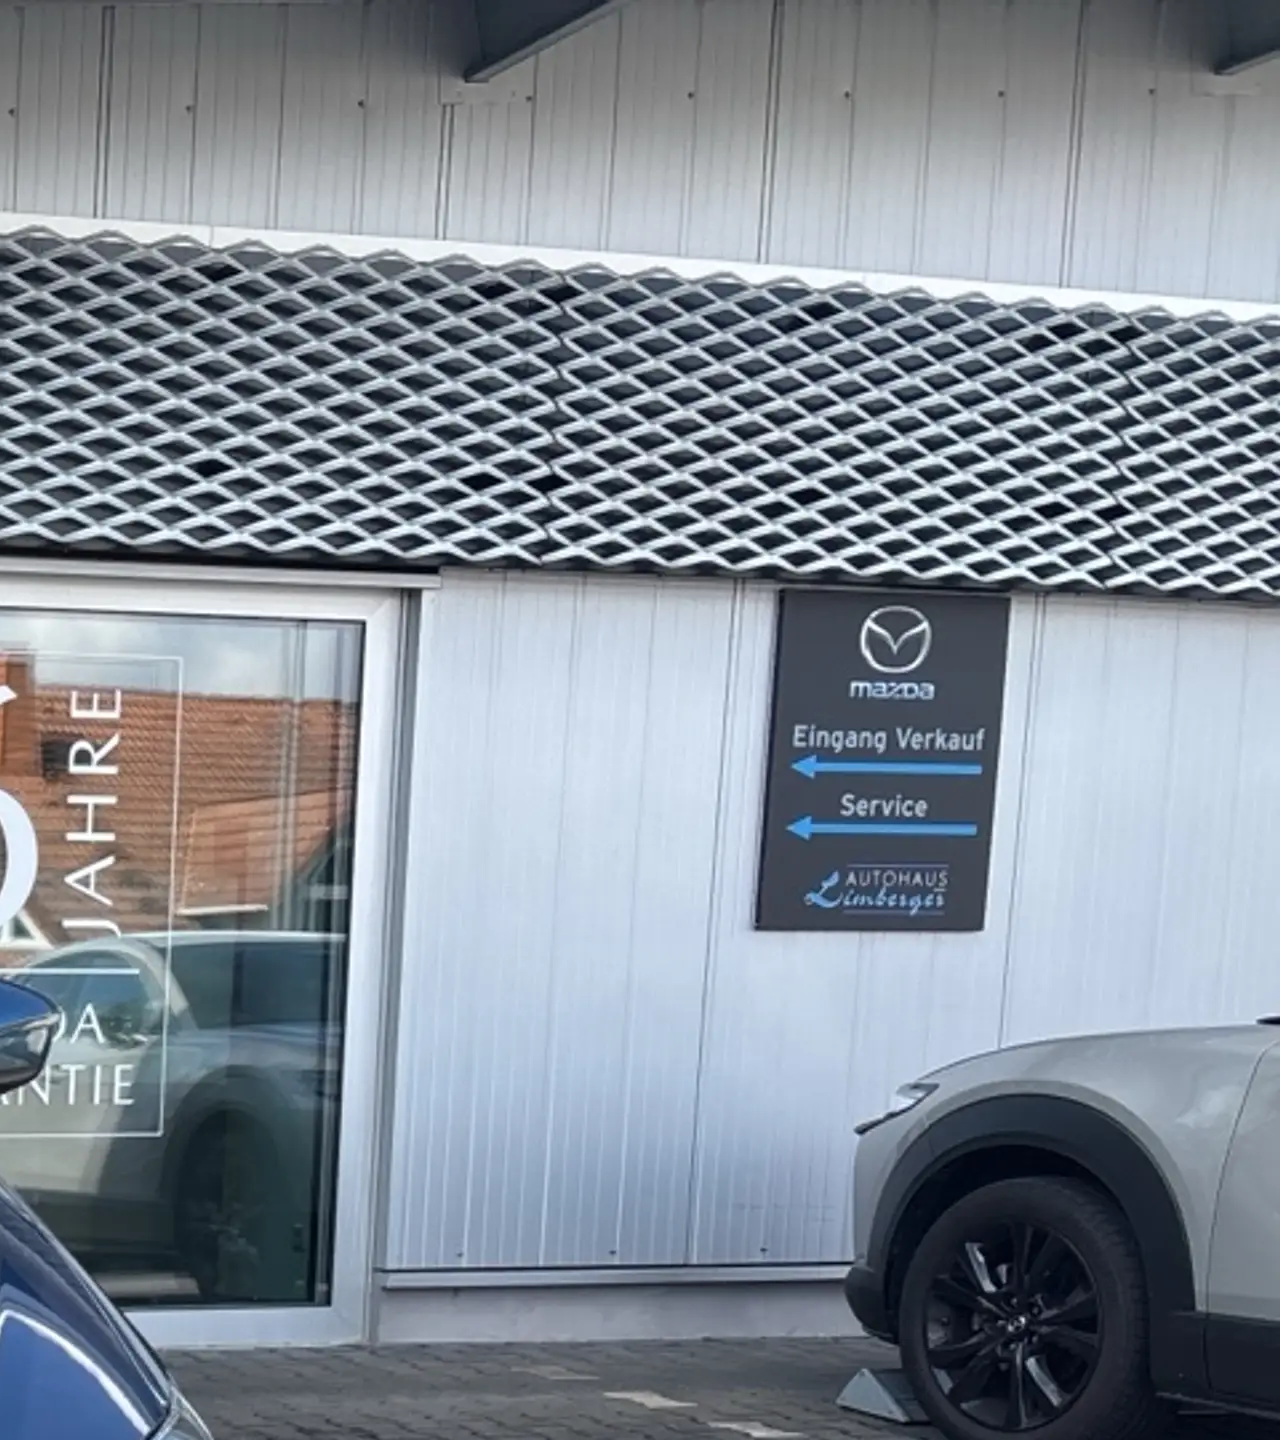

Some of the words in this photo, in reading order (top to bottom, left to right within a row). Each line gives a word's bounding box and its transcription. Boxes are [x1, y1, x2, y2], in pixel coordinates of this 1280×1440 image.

[848, 680, 936, 700] mazda
[792, 724, 888, 753] Eingang
[895, 727, 987, 751] Verkauf
[60, 688, 122, 938] JAHRE
[840, 794, 929, 818] Service
[845, 869, 949, 888] AUTOHAUS
[803, 870, 946, 916] Limberger
